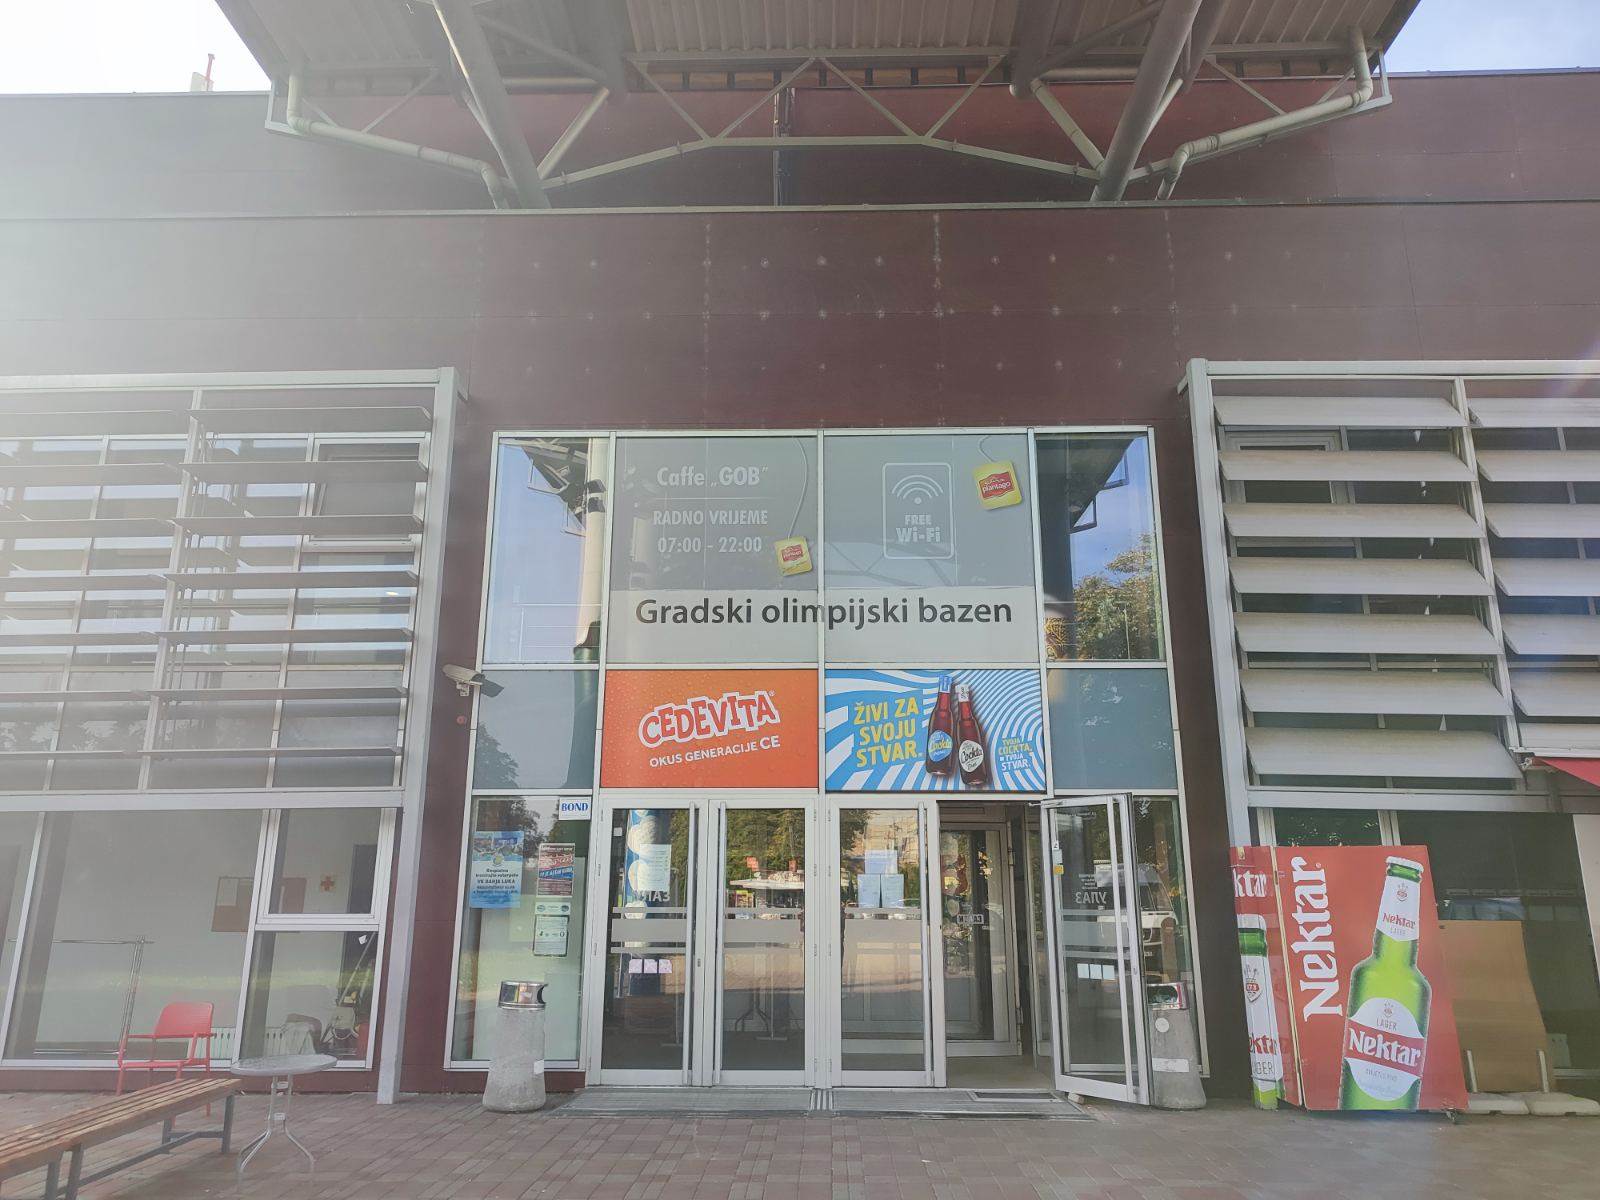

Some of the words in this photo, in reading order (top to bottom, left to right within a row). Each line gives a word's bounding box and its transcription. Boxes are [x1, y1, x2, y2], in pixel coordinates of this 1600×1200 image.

[656, 465, 706, 486] Caffe
[653, 509, 704, 525] RADNO
[708, 509, 769, 525] VRIJEME
[904, 514, 932, 525] FREE
[895, 526, 941, 543] Wi-Fi
[657, 536, 702, 553] 07:00
[718, 536, 762, 553] 22:00
[636, 598, 752, 625] Gradski
[762, 598, 908, 631] olimpijski
[918, 598, 1012, 625] bazen
[854, 701, 889, 725] ŽIVI
[894, 697, 919, 718] ZA
[859, 718, 916, 746] SVOJU
[649, 753, 683, 768] OKUS
[685, 741, 758, 763] GENERACIJE
[759, 735, 781, 750] CE
[561, 802, 589, 812] BOND
[1382, 912, 1416, 929] Nektar
[1290, 855, 1343, 1022] Nektar
[1376, 1018, 1397, 1031] LAGER
[1348, 1028, 1421, 1067] Nektar
